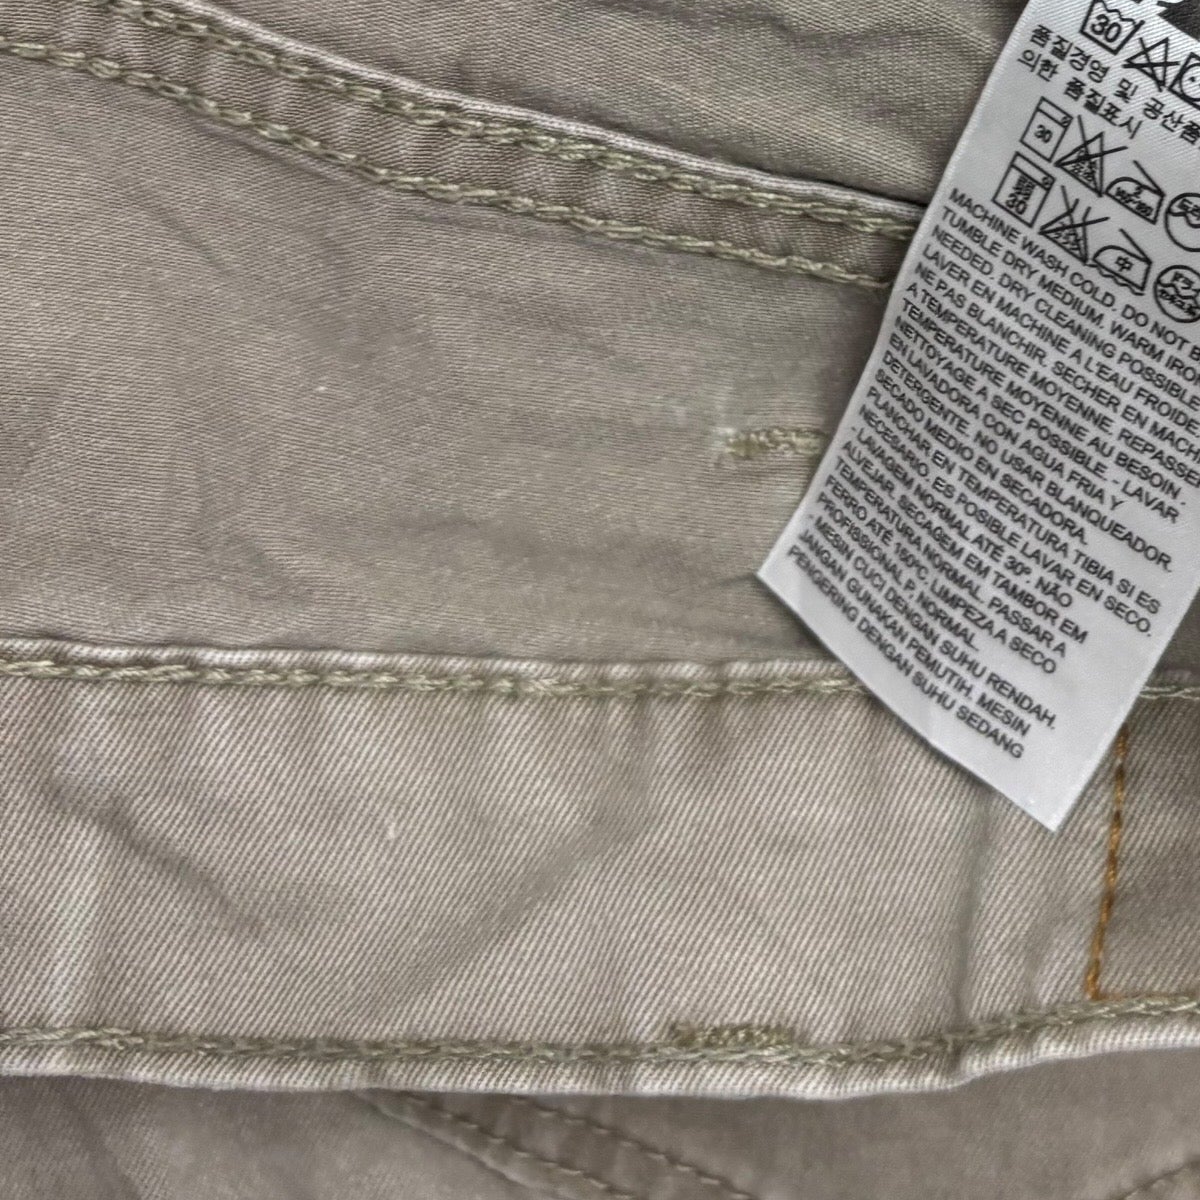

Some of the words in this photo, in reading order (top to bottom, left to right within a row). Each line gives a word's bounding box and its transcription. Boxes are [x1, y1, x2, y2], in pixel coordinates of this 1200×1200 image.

[1088, 11, 1124, 45] 30
[921, 243, 971, 286] LAVER
[970, 278, 997, 304] EN
[995, 295, 1071, 354] MACHINE
[1083, 354, 1134, 395] L'EAU
[938, 205, 1004, 258] TUMBLE
[1000, 248, 1039, 282] DRY
[1107, 320, 1165, 363] WARM
[948, 187, 1022, 246] MACHINE
[1018, 236, 1070, 279] WASH
[1120, 303, 1150, 330] DO
[1148, 319, 1190, 353] NOT
[996, 271, 1035, 305] DRY
[1032, 296, 1118, 360] CLEANING
[1115, 256, 1133, 274] 中
[912, 261, 937, 286] NE
[934, 277, 967, 309] PAS
[1050, 358, 1122, 414] SECHER
[1120, 403, 1149, 429] EN
[855, 426, 916, 490] LAVAGEM
[912, 482, 974, 542] NORMAL
[970, 531, 1007, 564] ATÉ
[1033, 574, 1076, 611] NÃO
[895, 493, 965, 560] SECAGEM
[962, 551, 991, 579] EM
[988, 569, 1061, 627] TAMBOR
[1058, 615, 1088, 645] EM
[813, 515, 854, 561] MESIN
[850, 553, 888, 593] CUCI
[883, 585, 941, 645] DENGAN
[937, 636, 988, 681] SUHU
[855, 615, 913, 677] DENGAN
[909, 668, 956, 713] SUHU
[954, 702, 1026, 761] SEDANG
